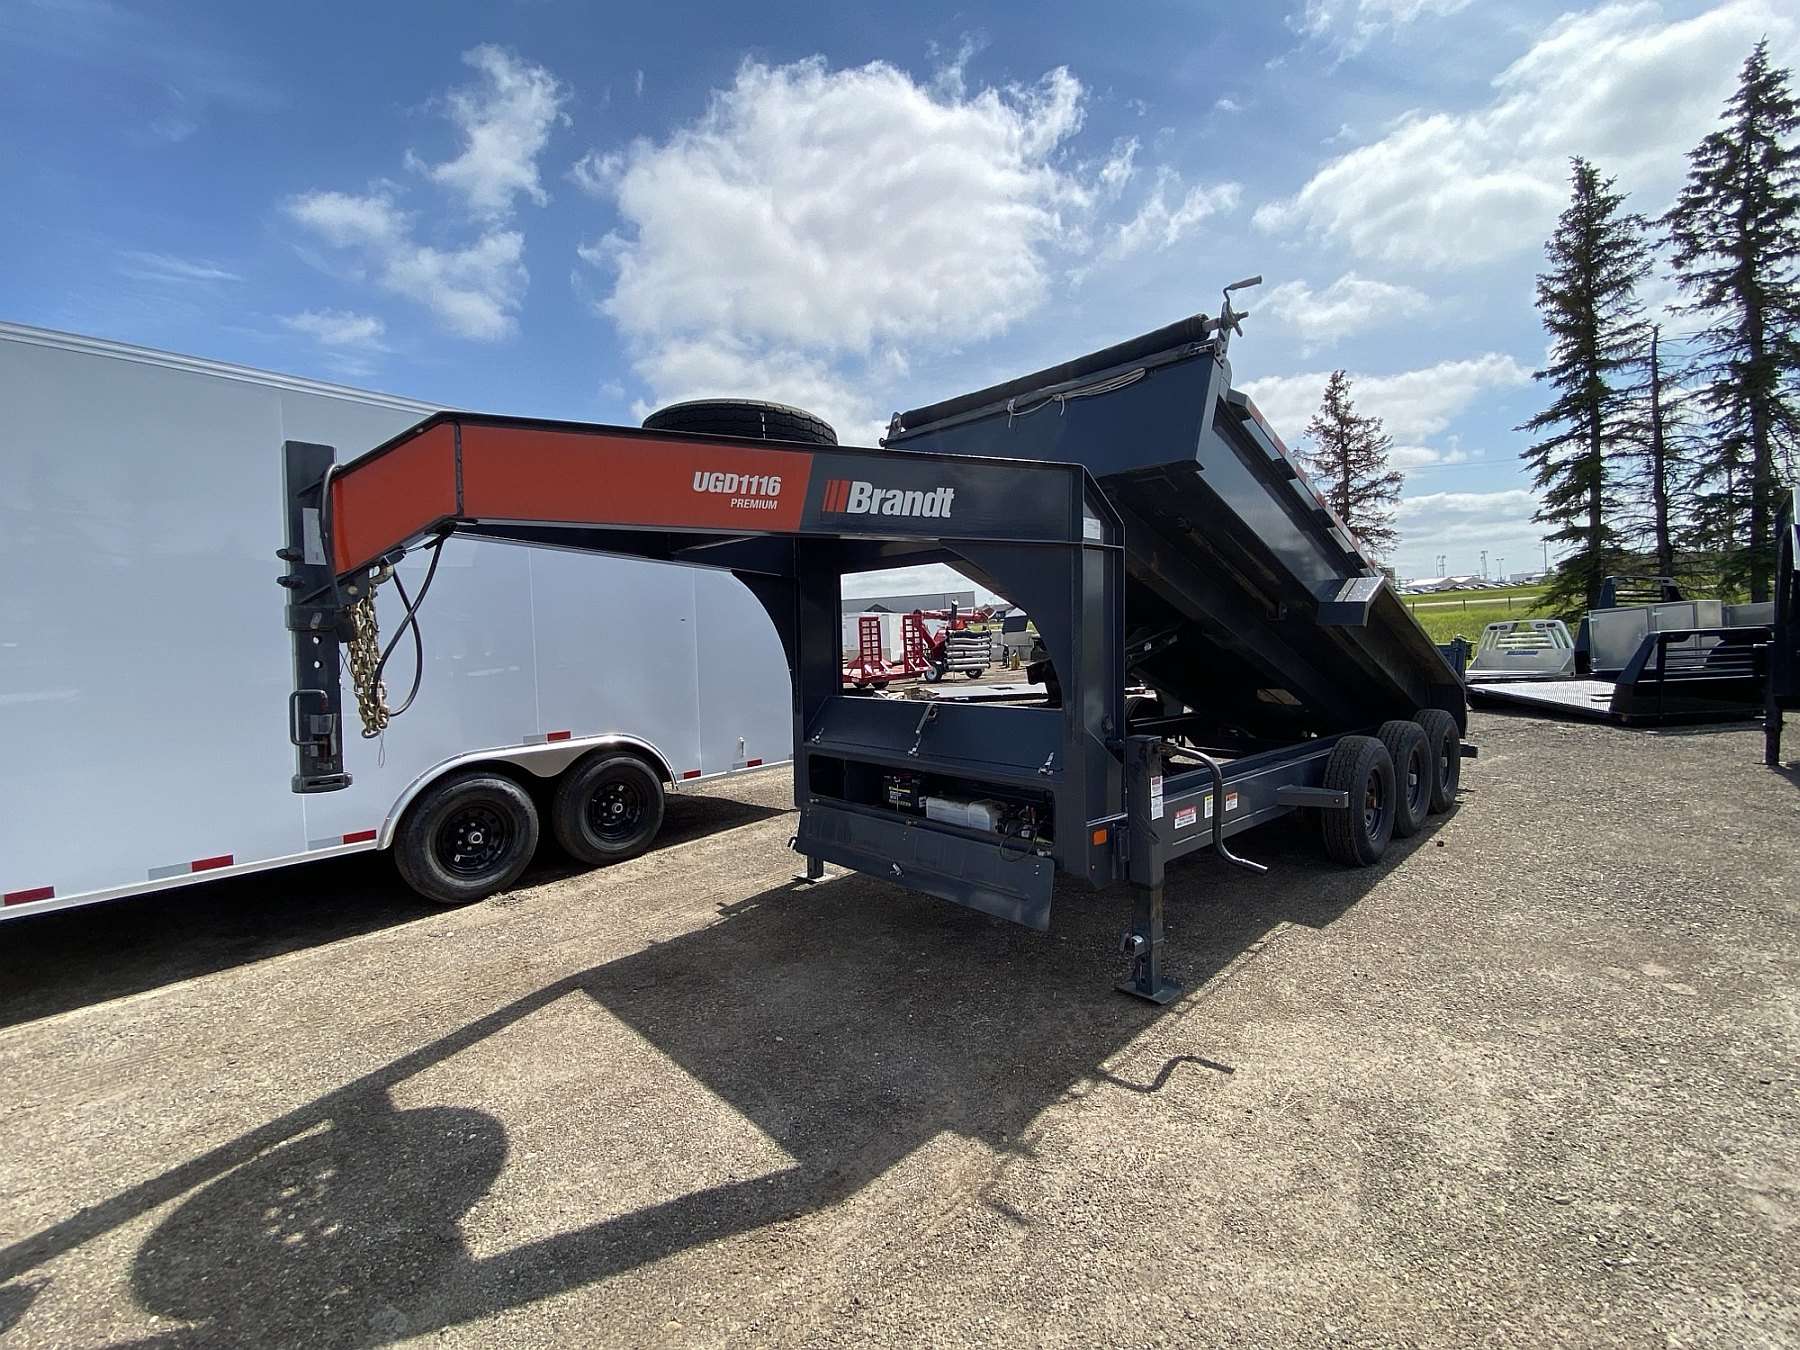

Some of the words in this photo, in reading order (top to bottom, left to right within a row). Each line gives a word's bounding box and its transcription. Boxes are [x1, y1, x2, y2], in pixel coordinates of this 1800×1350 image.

[693, 471, 782, 496] UGD1116
[730, 498, 778, 510] PREMIUM
[846, 481, 954, 518] Brandt
